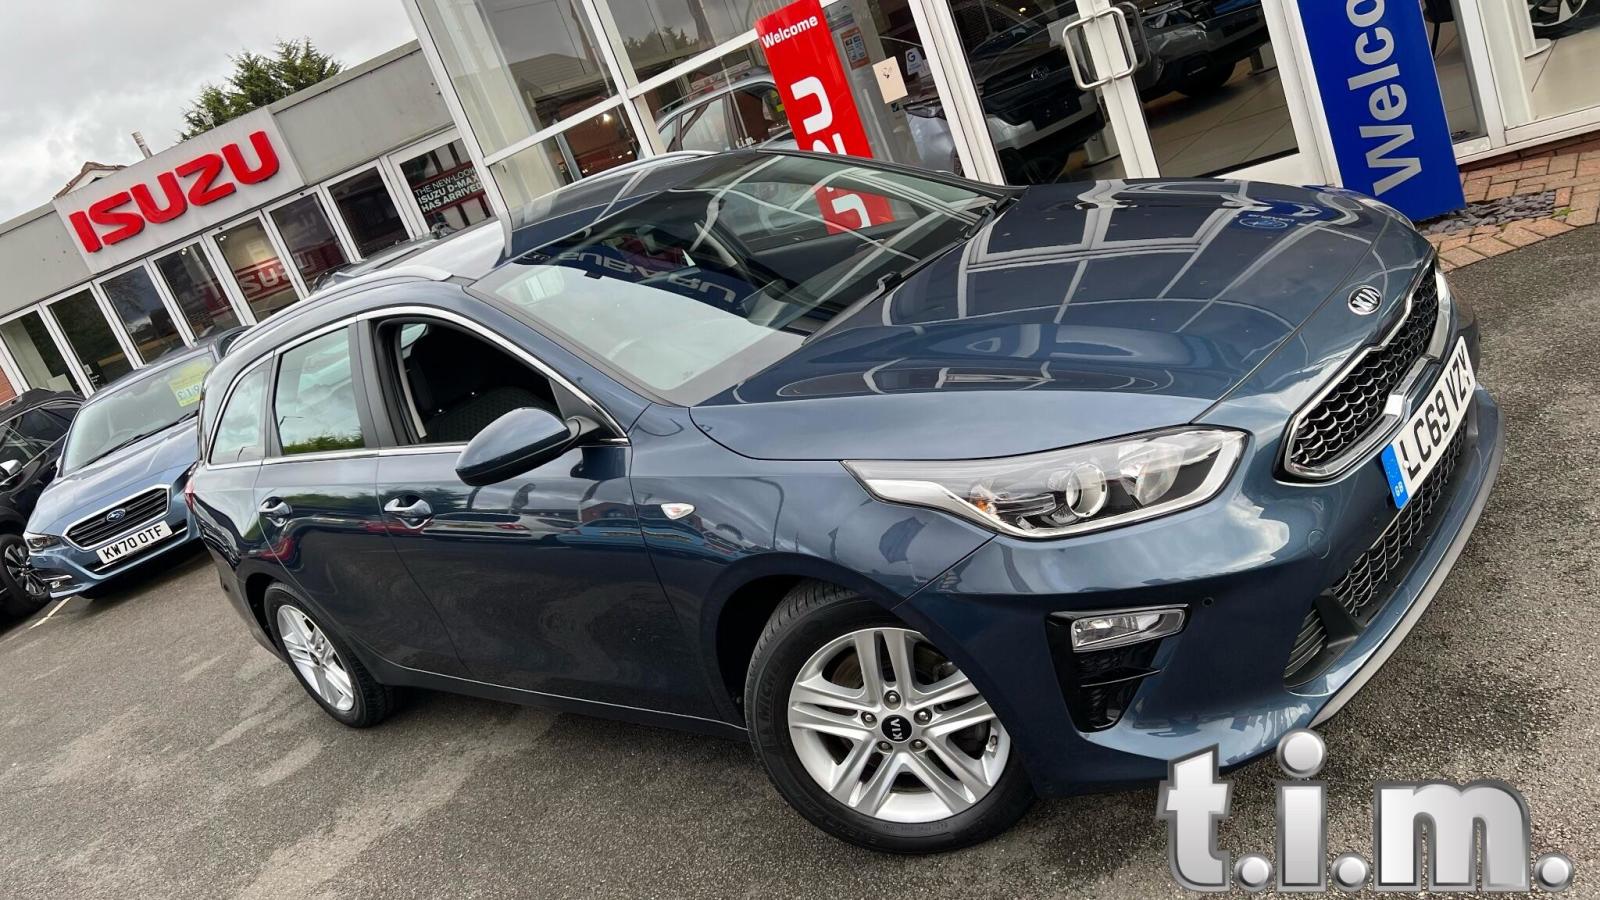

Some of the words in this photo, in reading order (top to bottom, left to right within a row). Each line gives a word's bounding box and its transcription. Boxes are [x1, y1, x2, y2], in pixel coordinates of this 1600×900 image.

[762, 15, 818, 48] Welcome
[1345, 0, 1423, 197] Welco
[69, 130, 280, 253] ISUZU
[414, 185, 432, 197] THE
[417, 188, 446, 204] ISUZU
[446, 173, 480, 192] D-MAX
[420, 198, 442, 212] HAS
[443, 182, 484, 205] ARRIVED
[1351, 287, 1381, 312] KIA
[1400, 388, 1451, 482] LC69
[1394, 481, 1405, 496] GB
[102, 537, 138, 559] KW70
[137, 525, 162, 543] OTF
[890, 718, 903, 740] KIA
